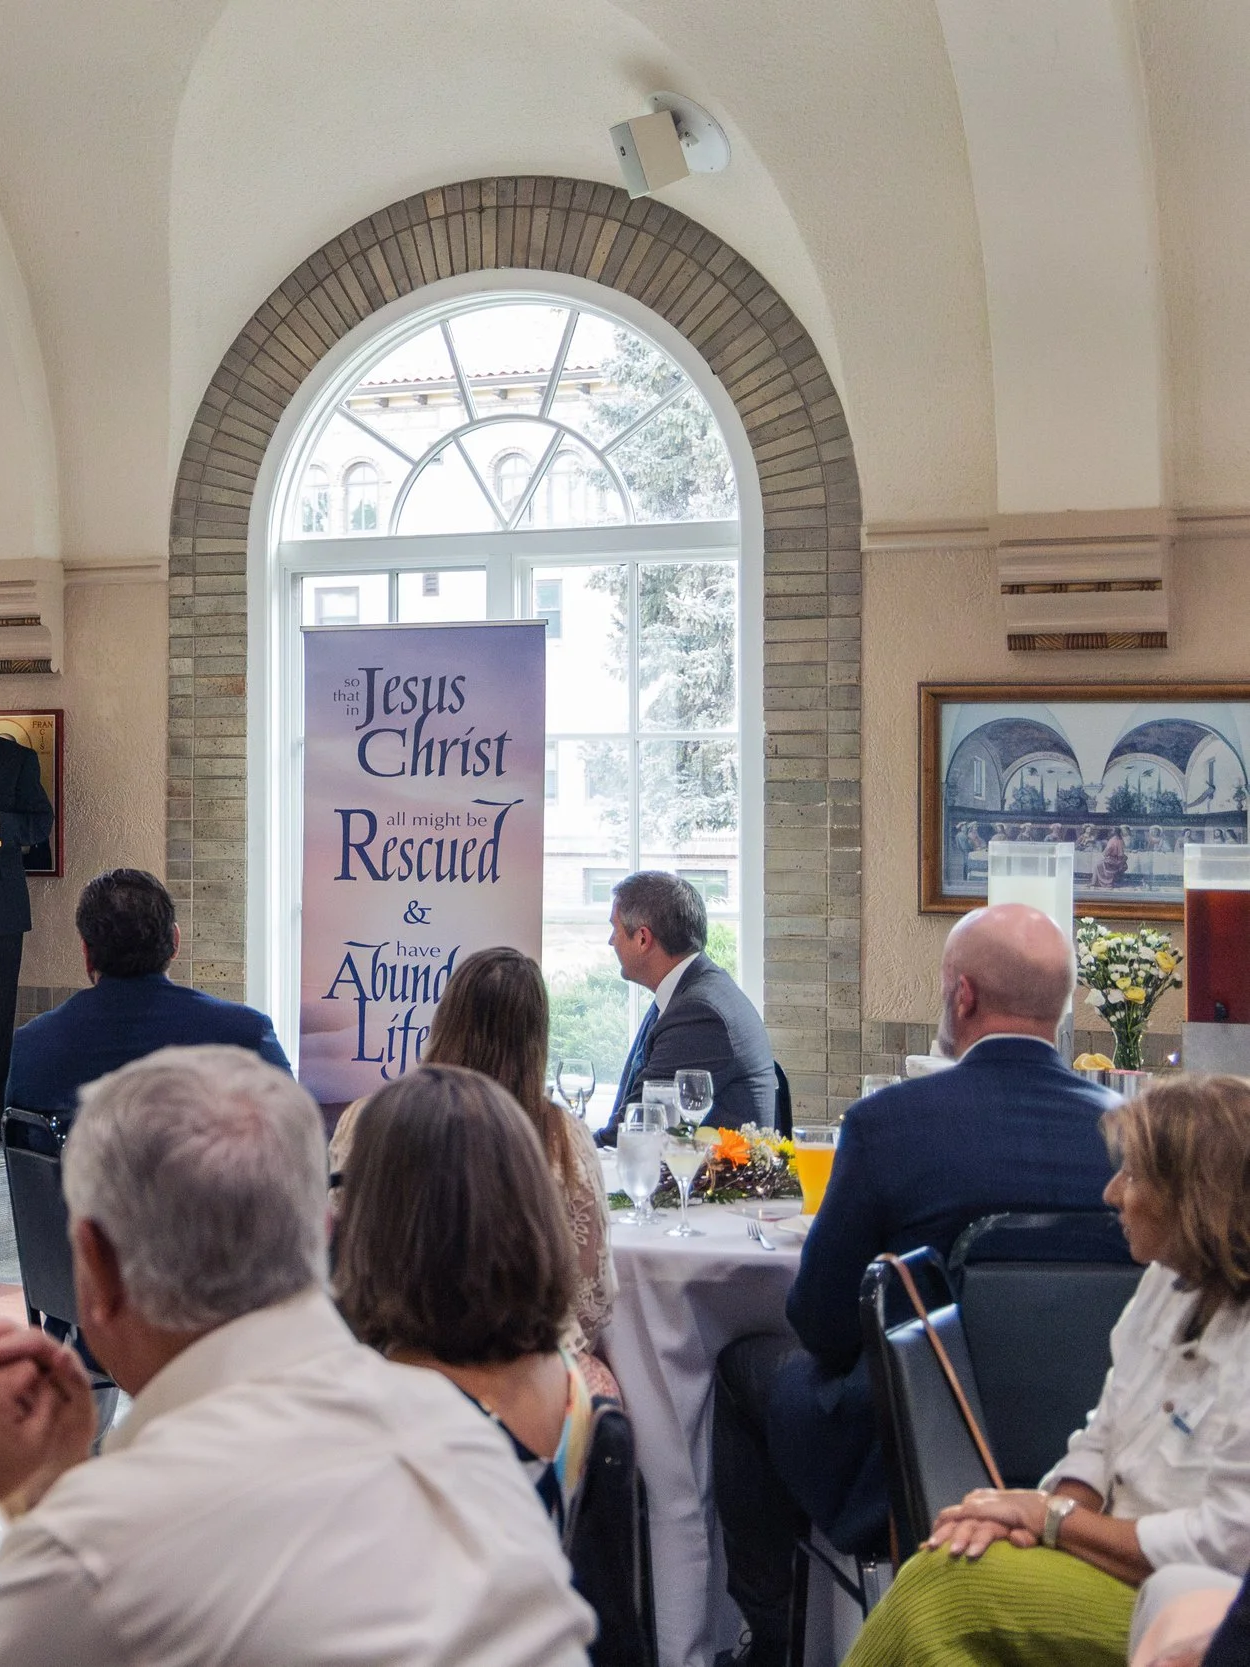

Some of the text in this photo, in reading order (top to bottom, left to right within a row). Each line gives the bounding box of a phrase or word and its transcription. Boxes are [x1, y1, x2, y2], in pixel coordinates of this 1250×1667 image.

[333, 689, 360, 702] that
[344, 678, 360, 688] so
[346, 704, 359, 716] in
[355, 667, 466, 731] Jesus
[357, 714, 513, 778] Christ
[386, 811, 488, 831] all might be
[334, 798, 524, 883] Rescued
[403, 900, 432, 925] &
[396, 940, 441, 958] have
[321, 941, 461, 1004] Abund
[351, 998, 431, 1081] Life
